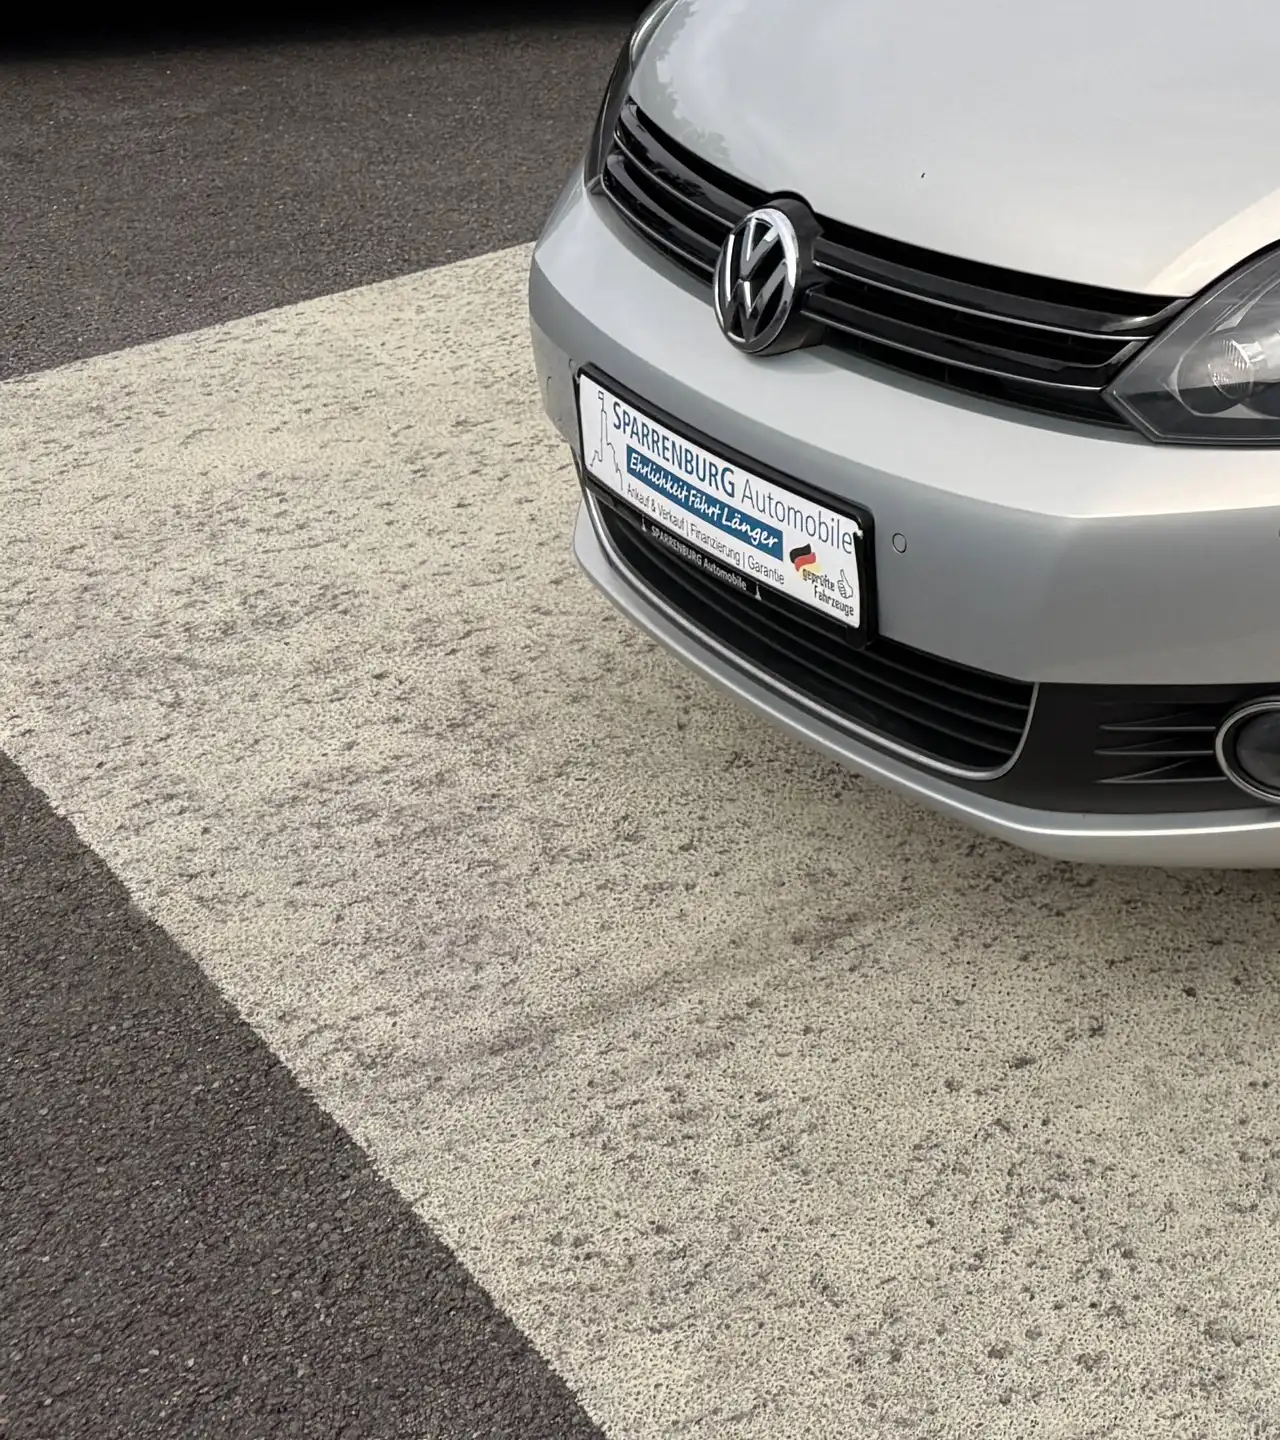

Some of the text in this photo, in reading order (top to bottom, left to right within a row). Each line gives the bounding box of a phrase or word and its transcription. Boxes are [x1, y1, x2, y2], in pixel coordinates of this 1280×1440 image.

[613, 401, 853, 555] SPARRENBURG Automobile
[630, 452, 779, 547] Ehrlichkeit Fährt Länger
[651, 525, 747, 591] SPARRENBURG Automobile
[690, 523, 740, 566] Finanzierung
[747, 555, 785, 585] Garantie
[814, 585, 854, 617] Fahrzeuge
